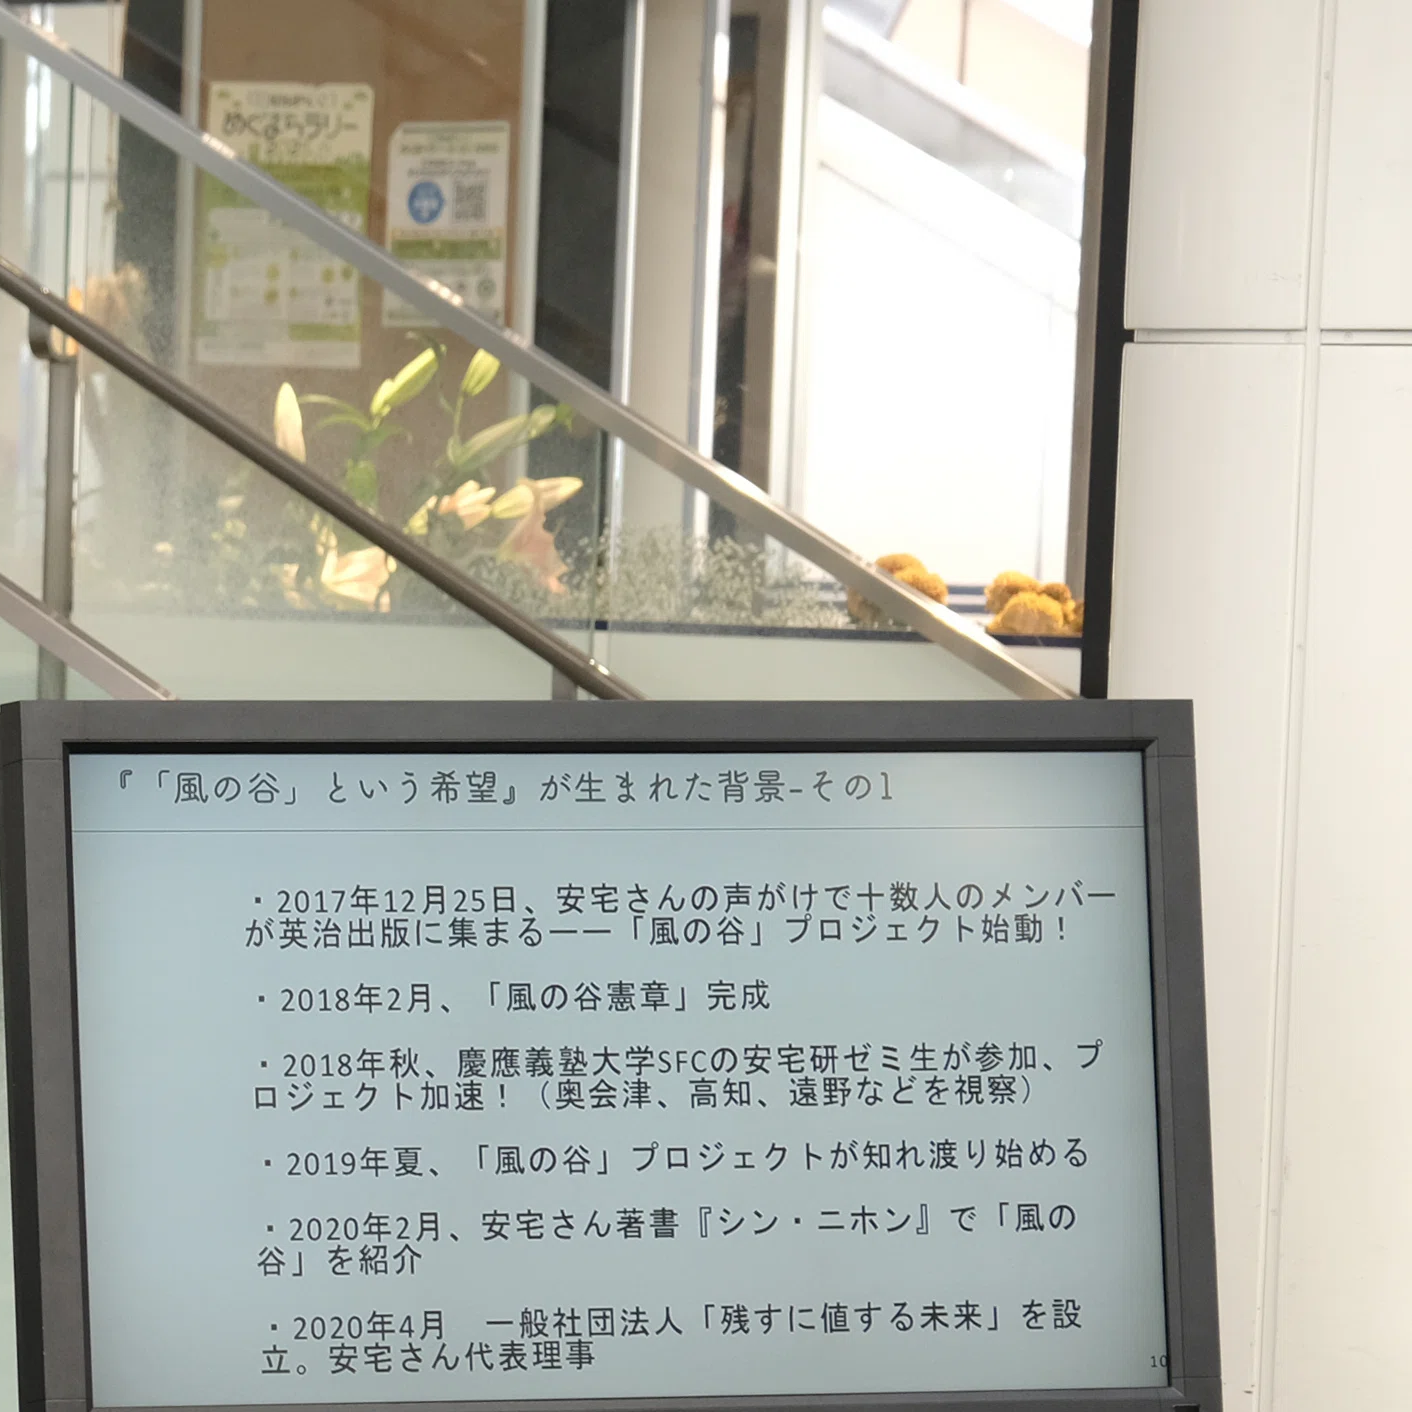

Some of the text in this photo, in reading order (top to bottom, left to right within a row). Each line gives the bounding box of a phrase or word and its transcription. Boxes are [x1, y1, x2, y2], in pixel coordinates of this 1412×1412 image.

[257, 1244, 423, 1278] 谷」を紹介
[261, 1340, 596, 1376] 立。安宅さん代表理事
